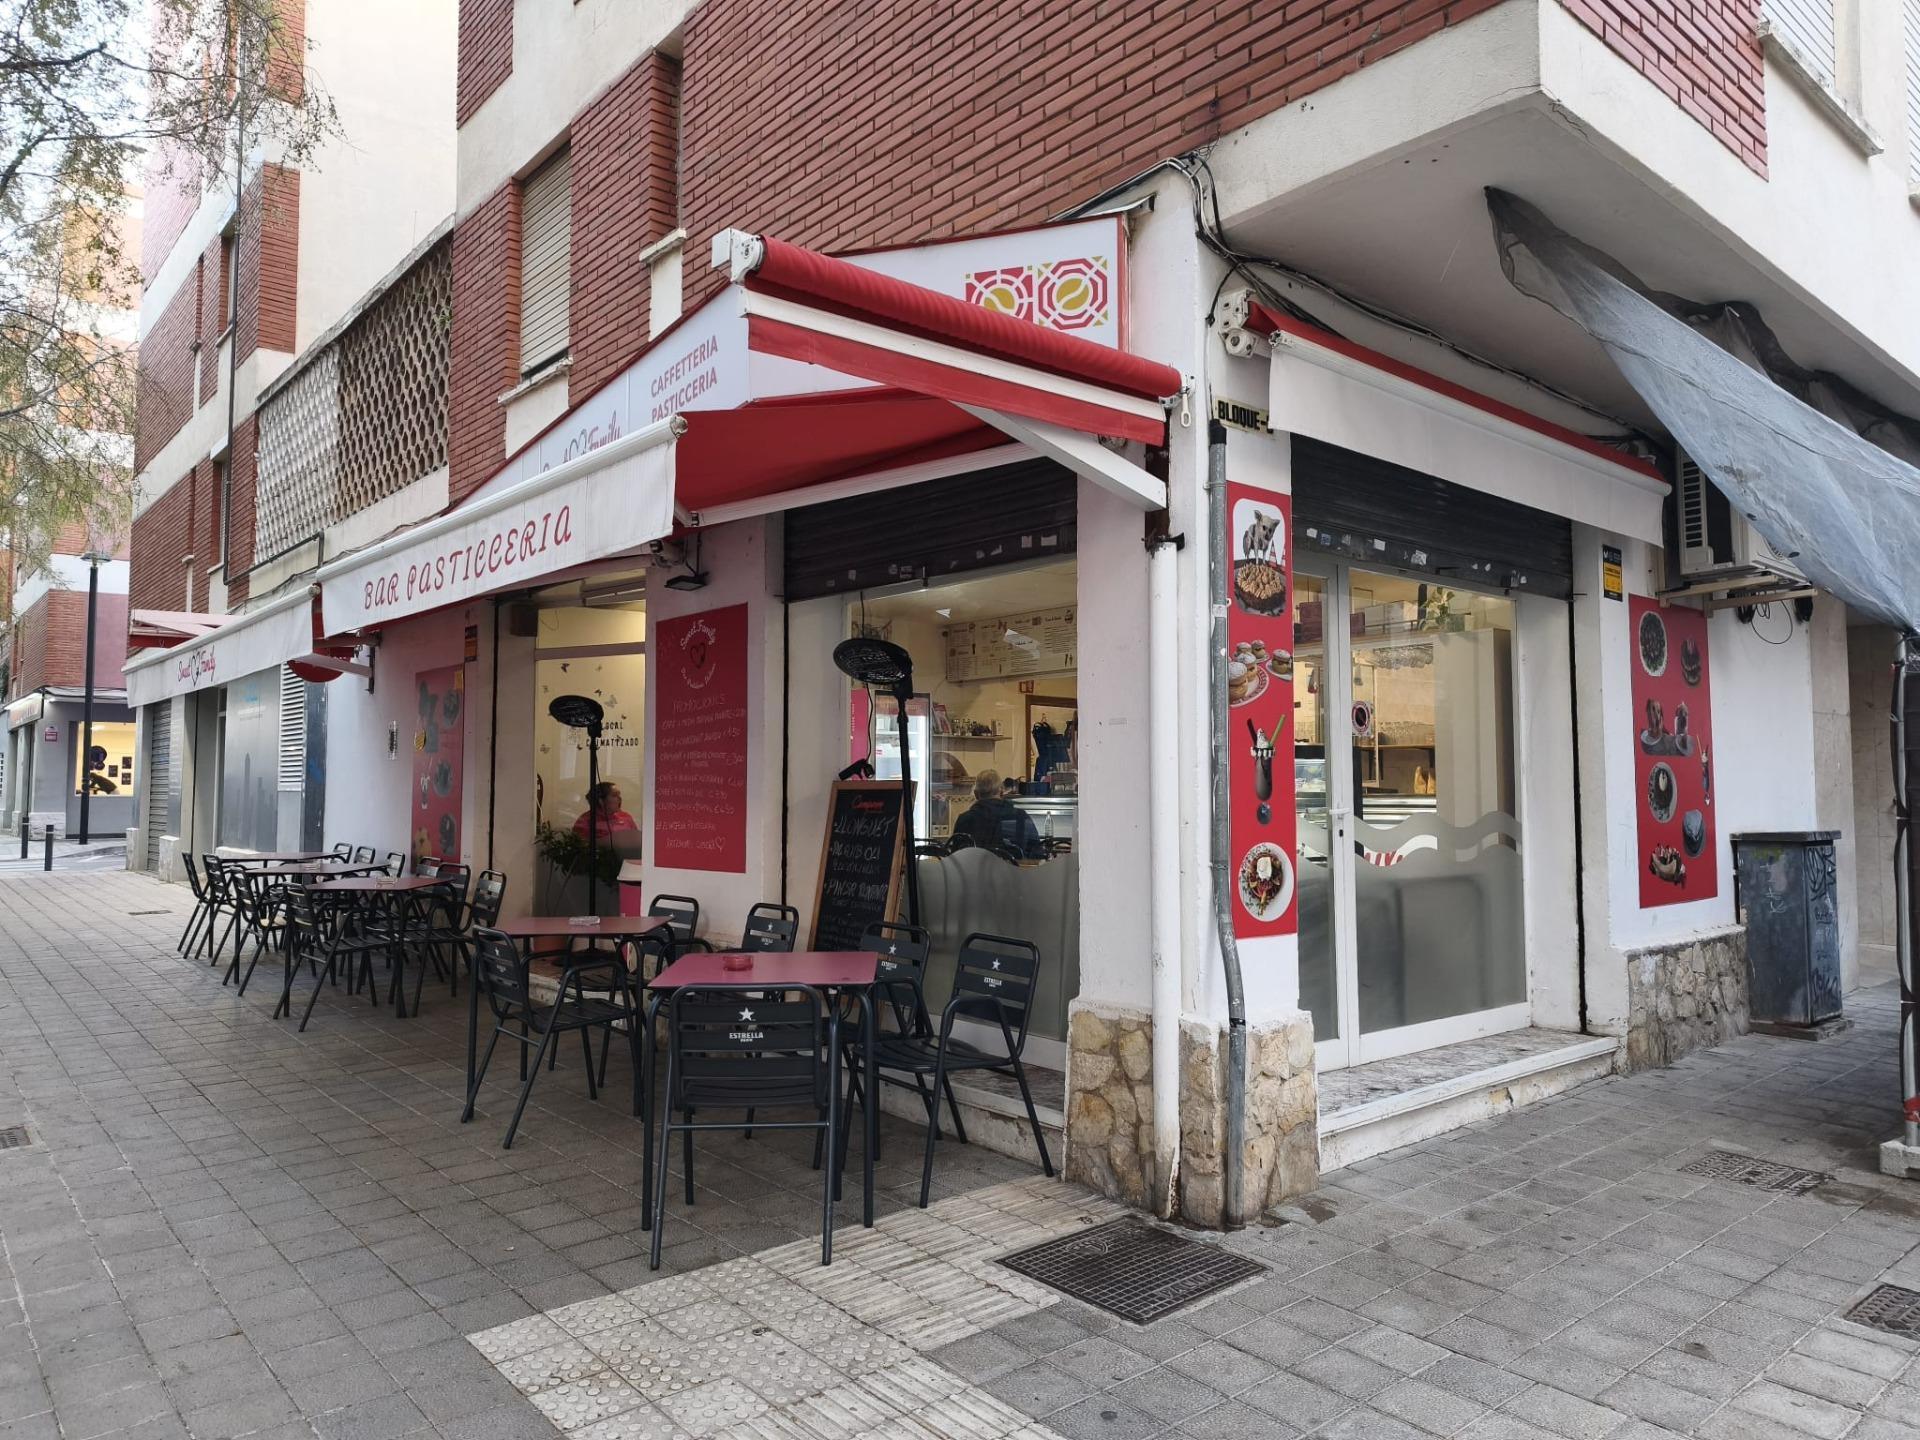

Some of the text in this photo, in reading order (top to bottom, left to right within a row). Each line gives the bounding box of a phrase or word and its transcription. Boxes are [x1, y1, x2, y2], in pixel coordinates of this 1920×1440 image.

[650, 334, 719, 398] CAFFETTERIA
[651, 366, 718, 423] PASTICCERIA
[363, 504, 573, 610] BAR PASTICCERIA
[585, 737, 639, 747] CIMATIZADO
[728, 1031, 764, 1039] ESTRELLA
